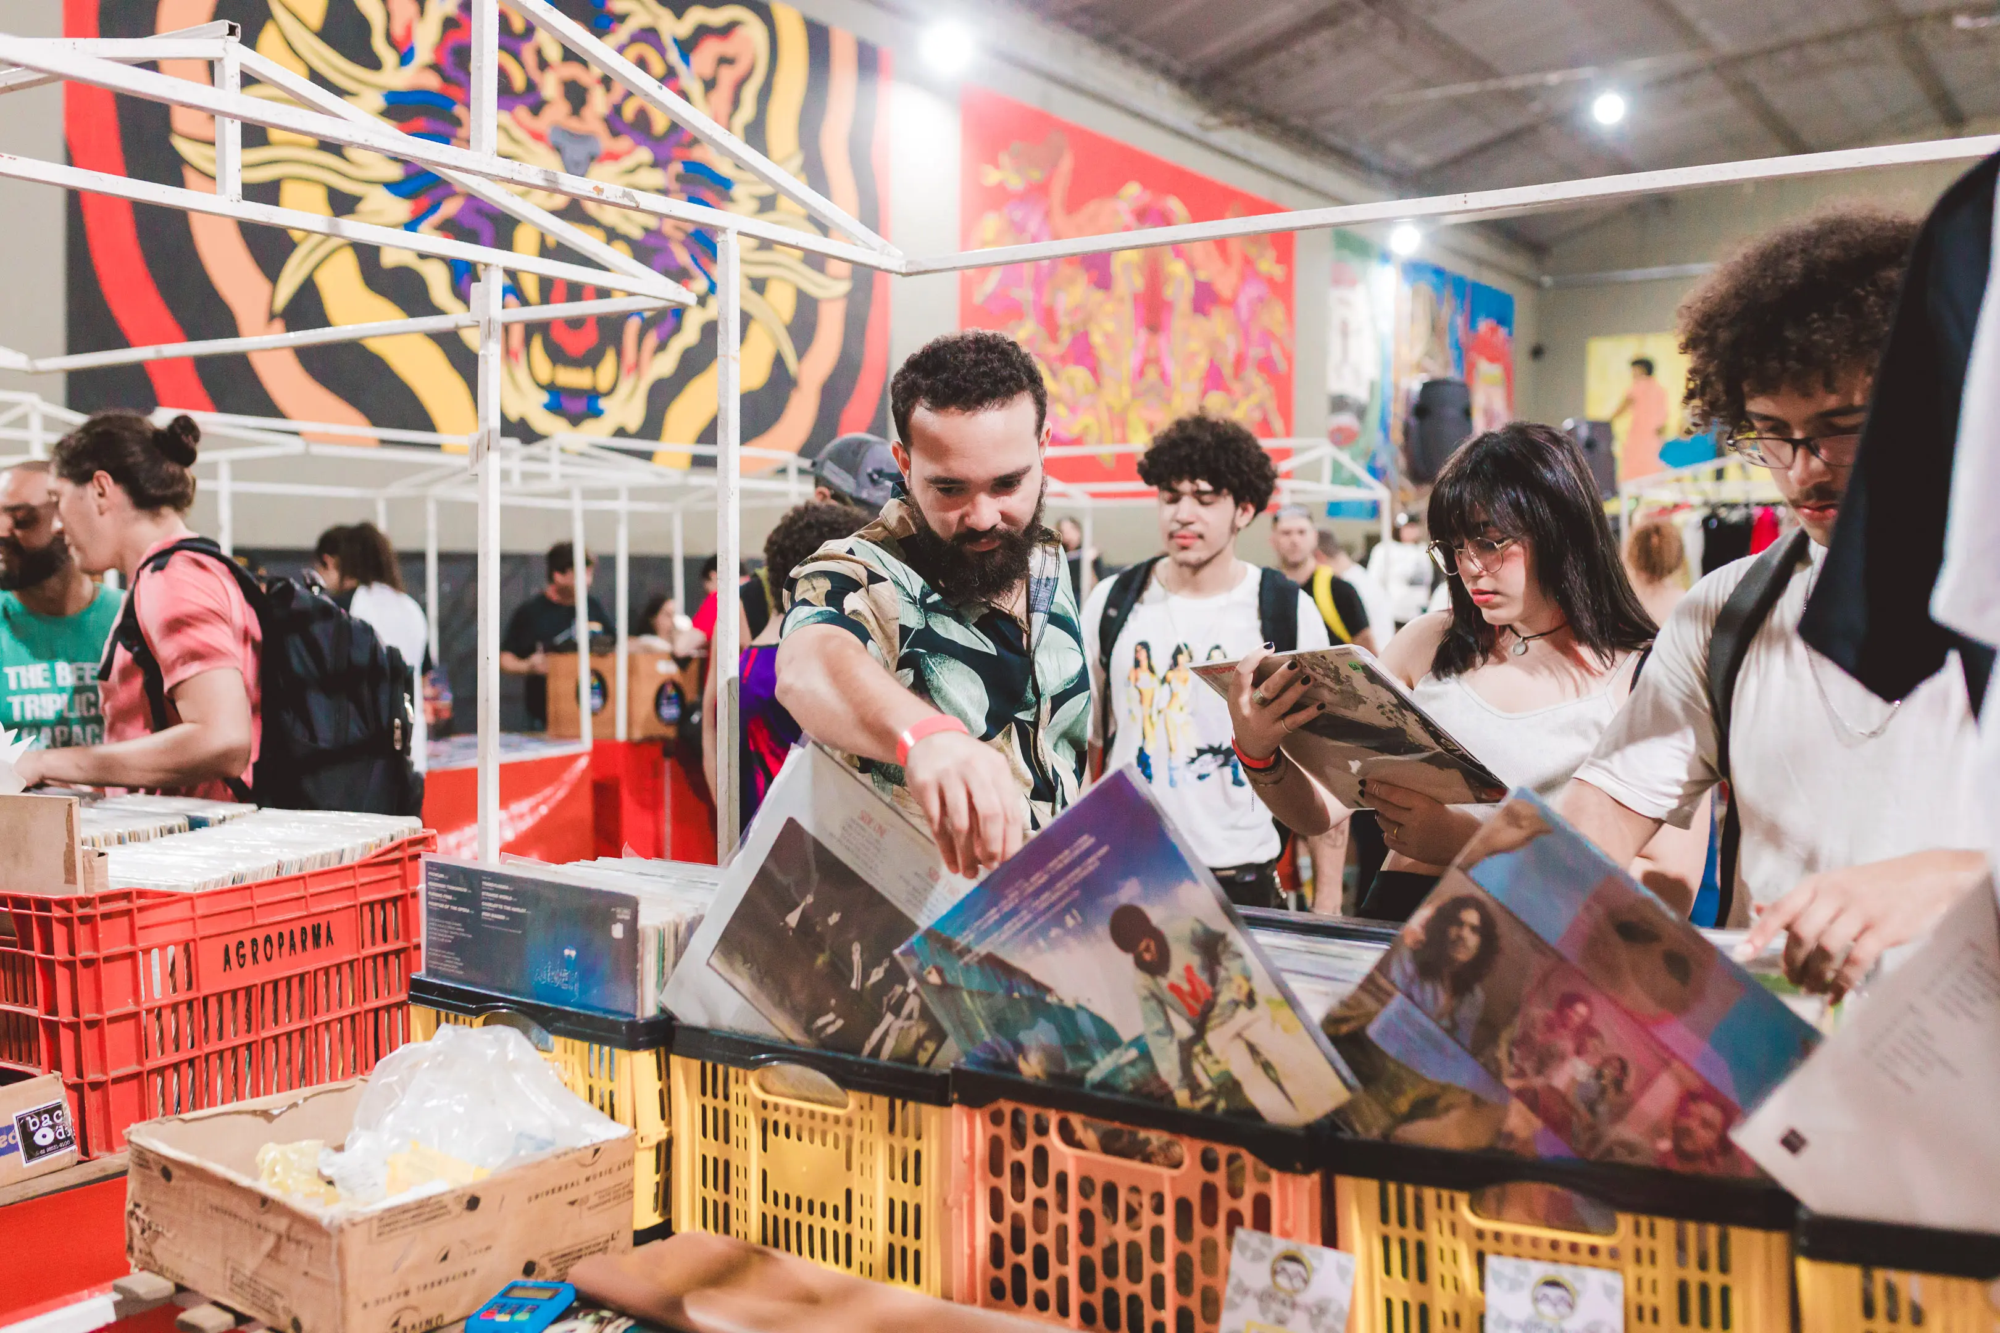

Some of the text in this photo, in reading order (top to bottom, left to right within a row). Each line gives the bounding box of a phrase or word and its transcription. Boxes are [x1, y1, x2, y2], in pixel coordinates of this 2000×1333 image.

[3, 663, 51, 690] THE
[7, 692, 100, 721] TRIPLIC
[223, 920, 334, 973] AGROPARMA
